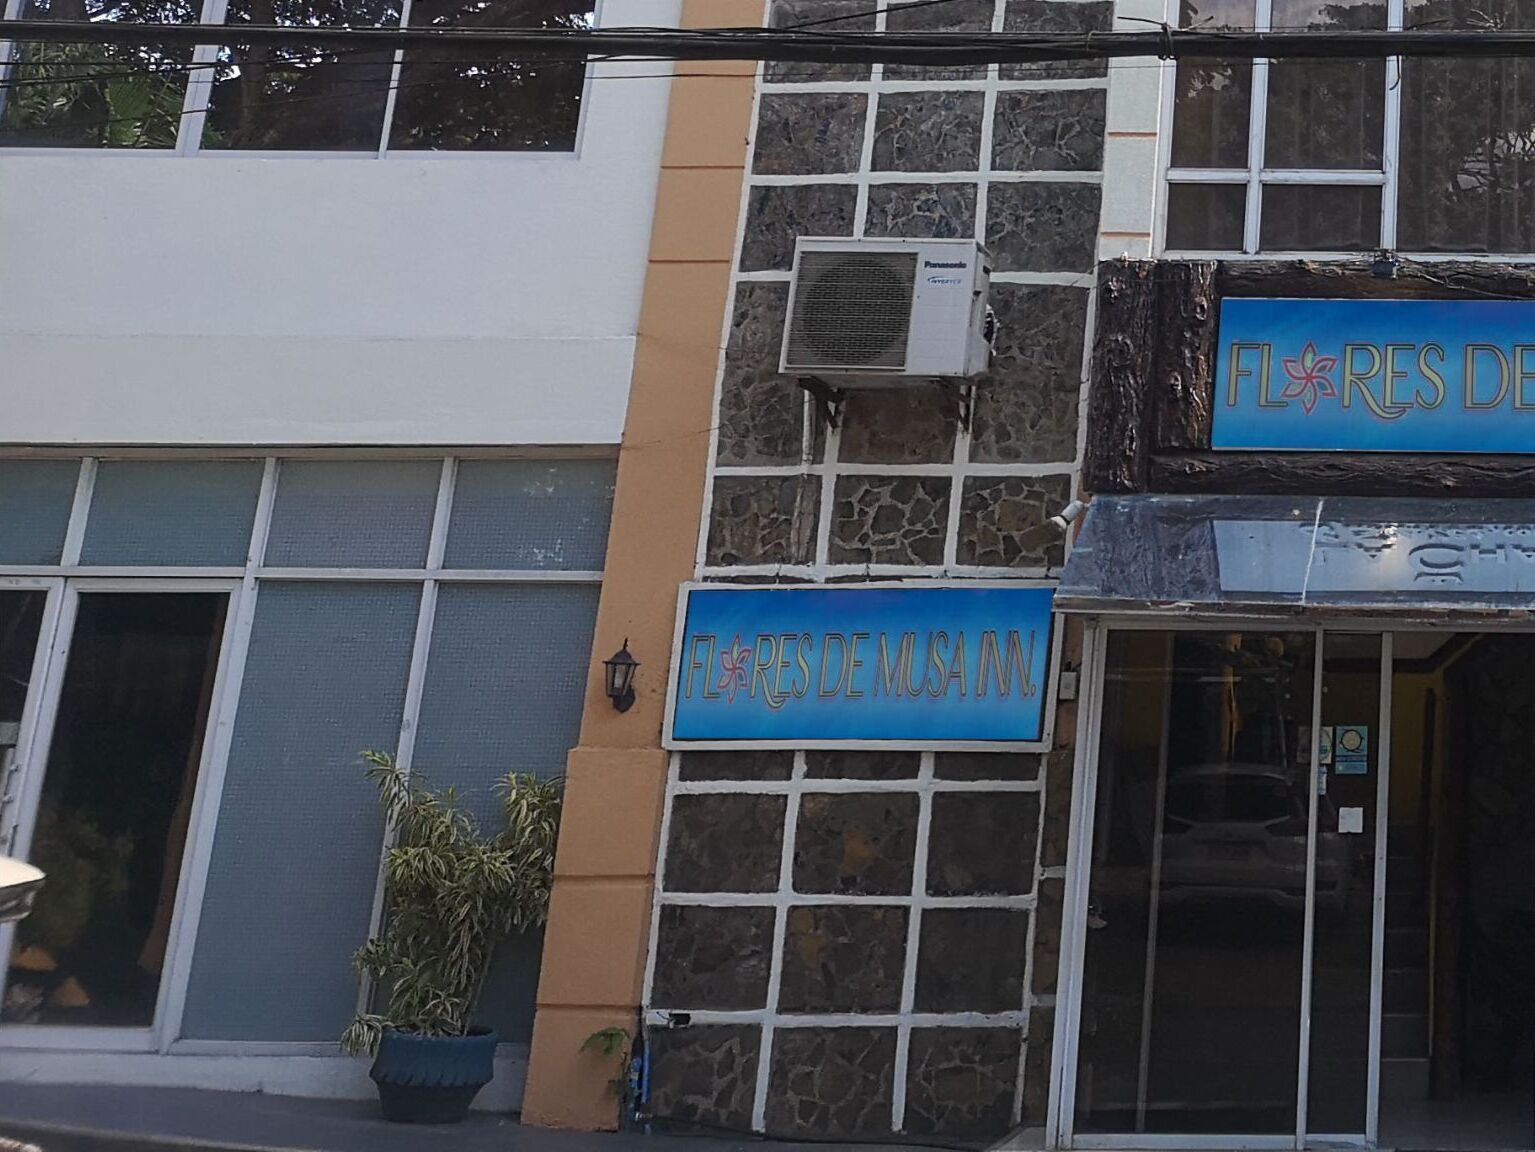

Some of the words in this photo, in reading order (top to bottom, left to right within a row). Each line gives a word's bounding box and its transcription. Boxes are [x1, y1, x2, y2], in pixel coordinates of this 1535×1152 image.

[924, 260, 967, 269] Panasonic
[818, 632, 870, 698] DE
[874, 631, 967, 698] MUSA
[976, 630, 1037, 698] INN.
